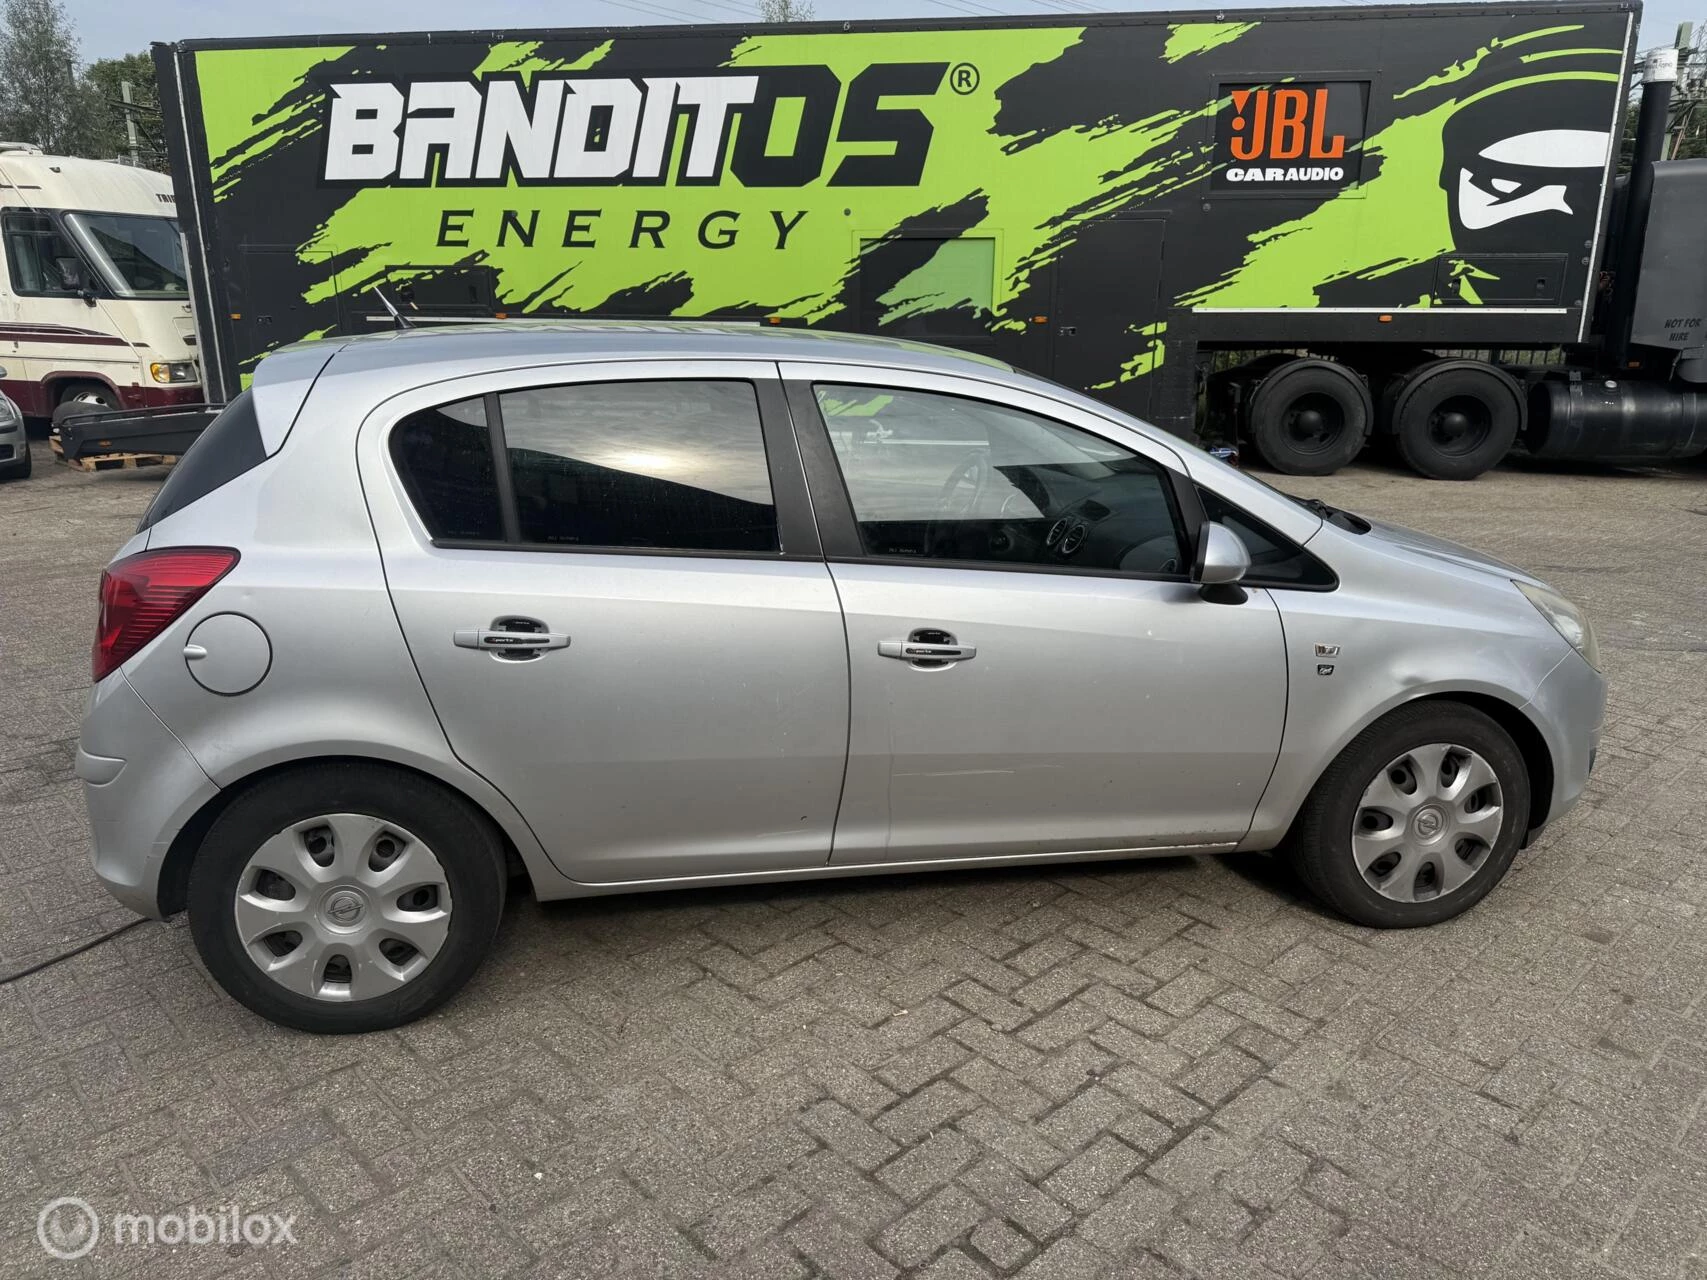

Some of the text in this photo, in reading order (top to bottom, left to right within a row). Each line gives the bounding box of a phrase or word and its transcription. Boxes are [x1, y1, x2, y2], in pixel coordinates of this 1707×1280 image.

[322, 62, 949, 187] BANDITOS
[1230, 88, 1345, 160] JBL
[437, 209, 806, 249] ENERGY
[1664, 318, 1702, 329] NOT FOR
